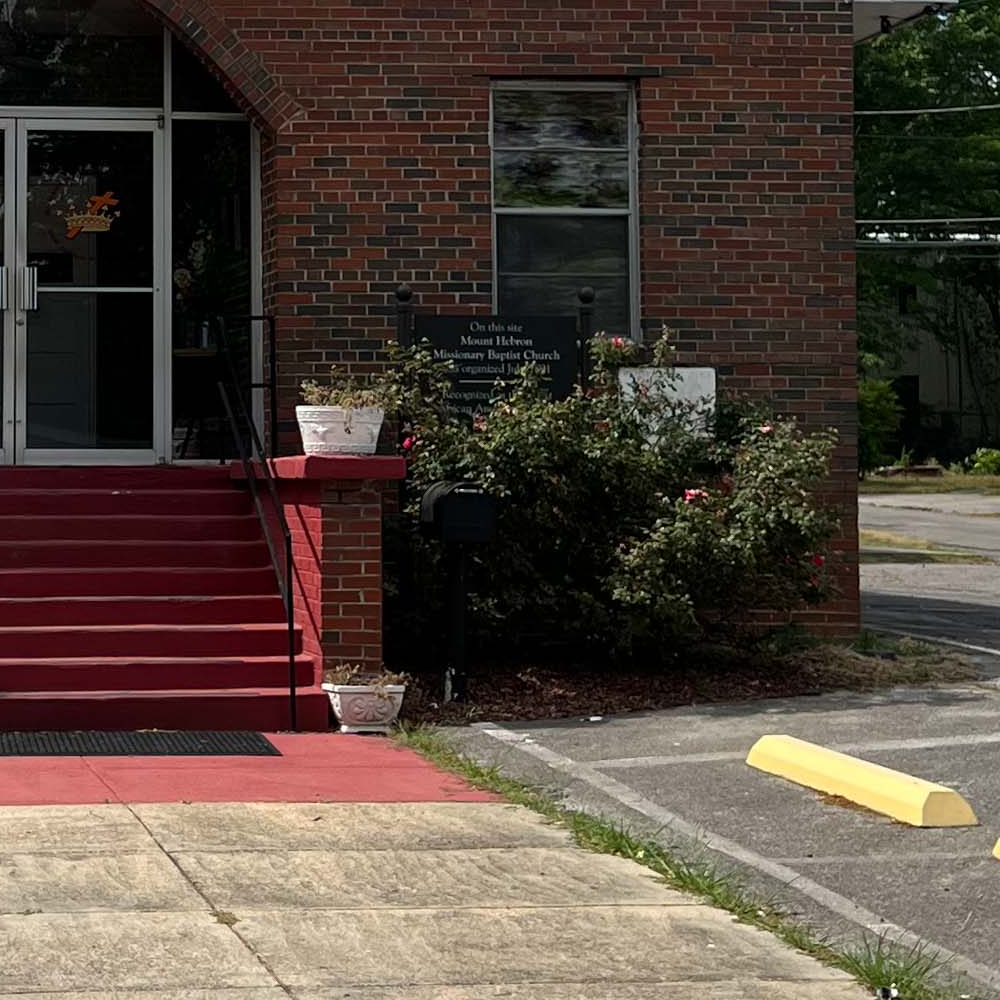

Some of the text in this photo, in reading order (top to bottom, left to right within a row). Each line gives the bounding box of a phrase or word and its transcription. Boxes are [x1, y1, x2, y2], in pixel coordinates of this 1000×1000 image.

[470, 321, 523, 332] On this site
[460, 335, 533, 346] Mount Hebron
[433, 349, 560, 361] Missionary Baptist Church
